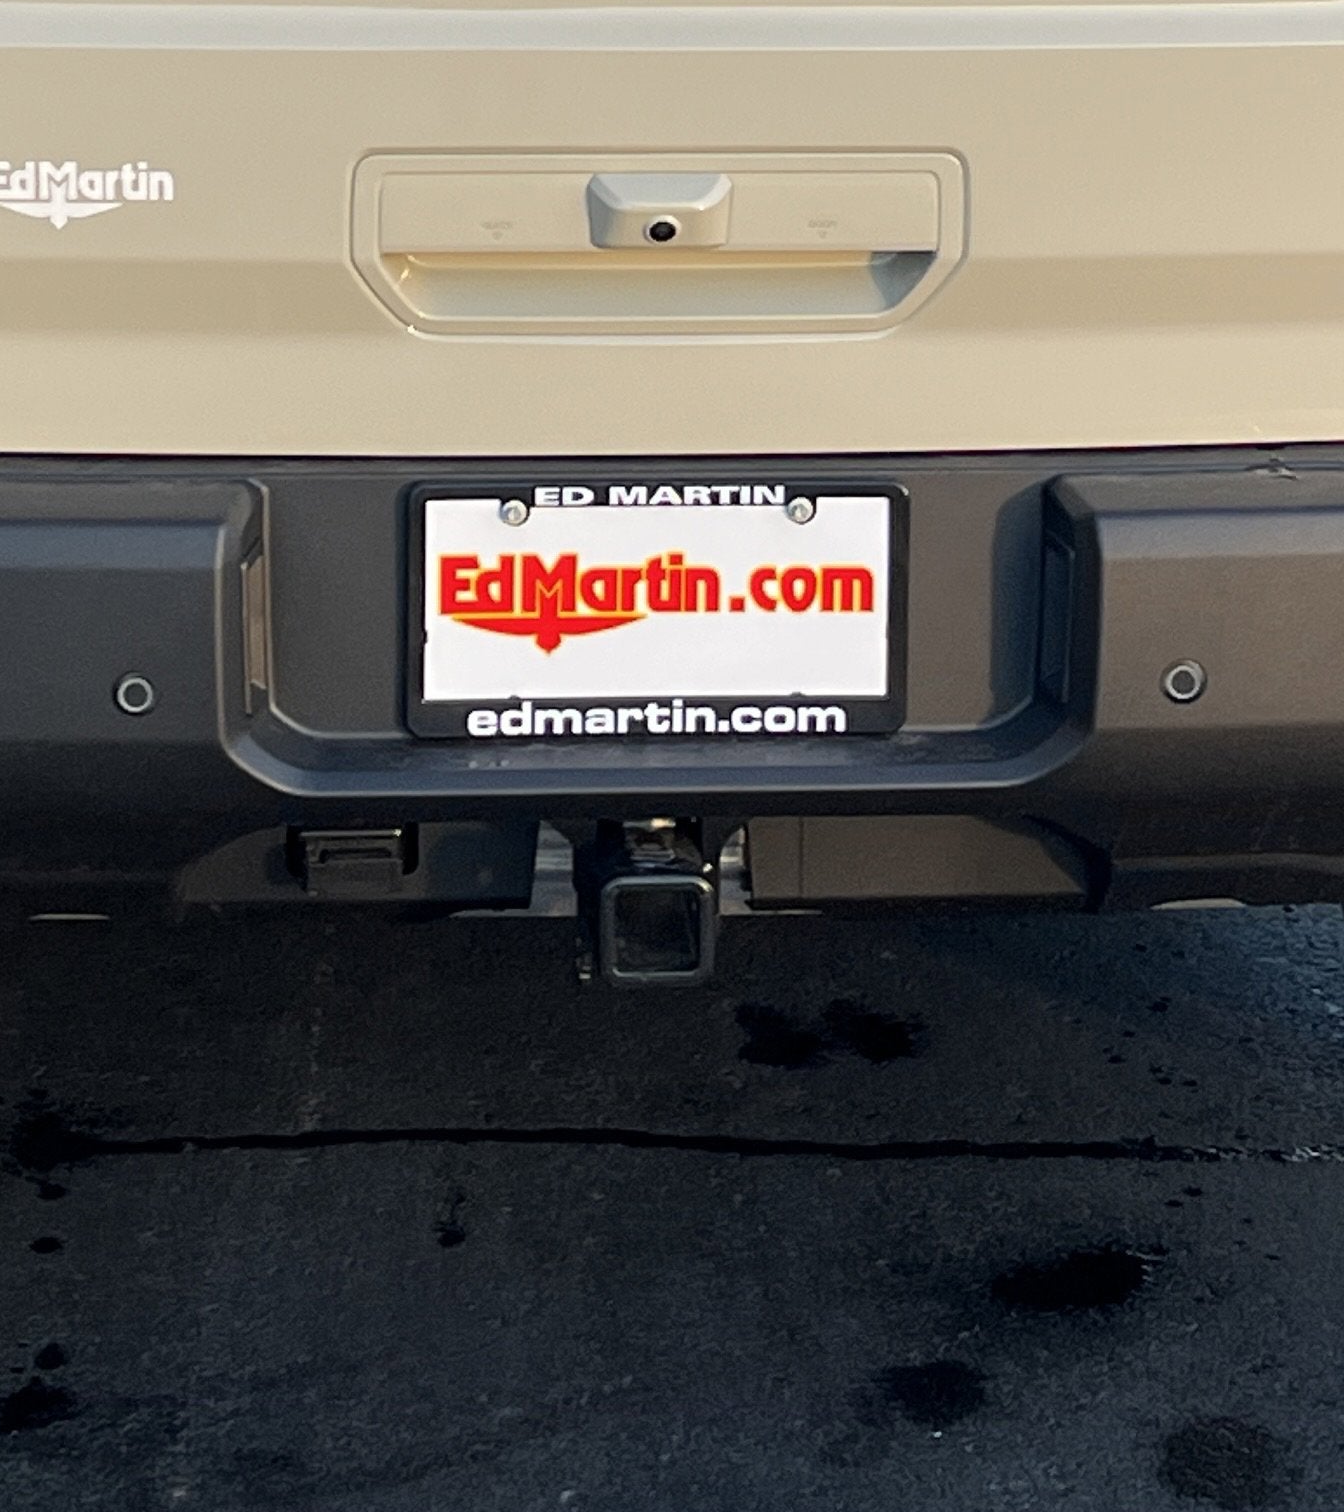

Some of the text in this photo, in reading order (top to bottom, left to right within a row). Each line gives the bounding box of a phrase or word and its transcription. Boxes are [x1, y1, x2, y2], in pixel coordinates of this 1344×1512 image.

[533, 484, 786, 507] ED MARTIN
[439, 552, 874, 614] EdMartin.com
[467, 699, 847, 737] edmartin.com
